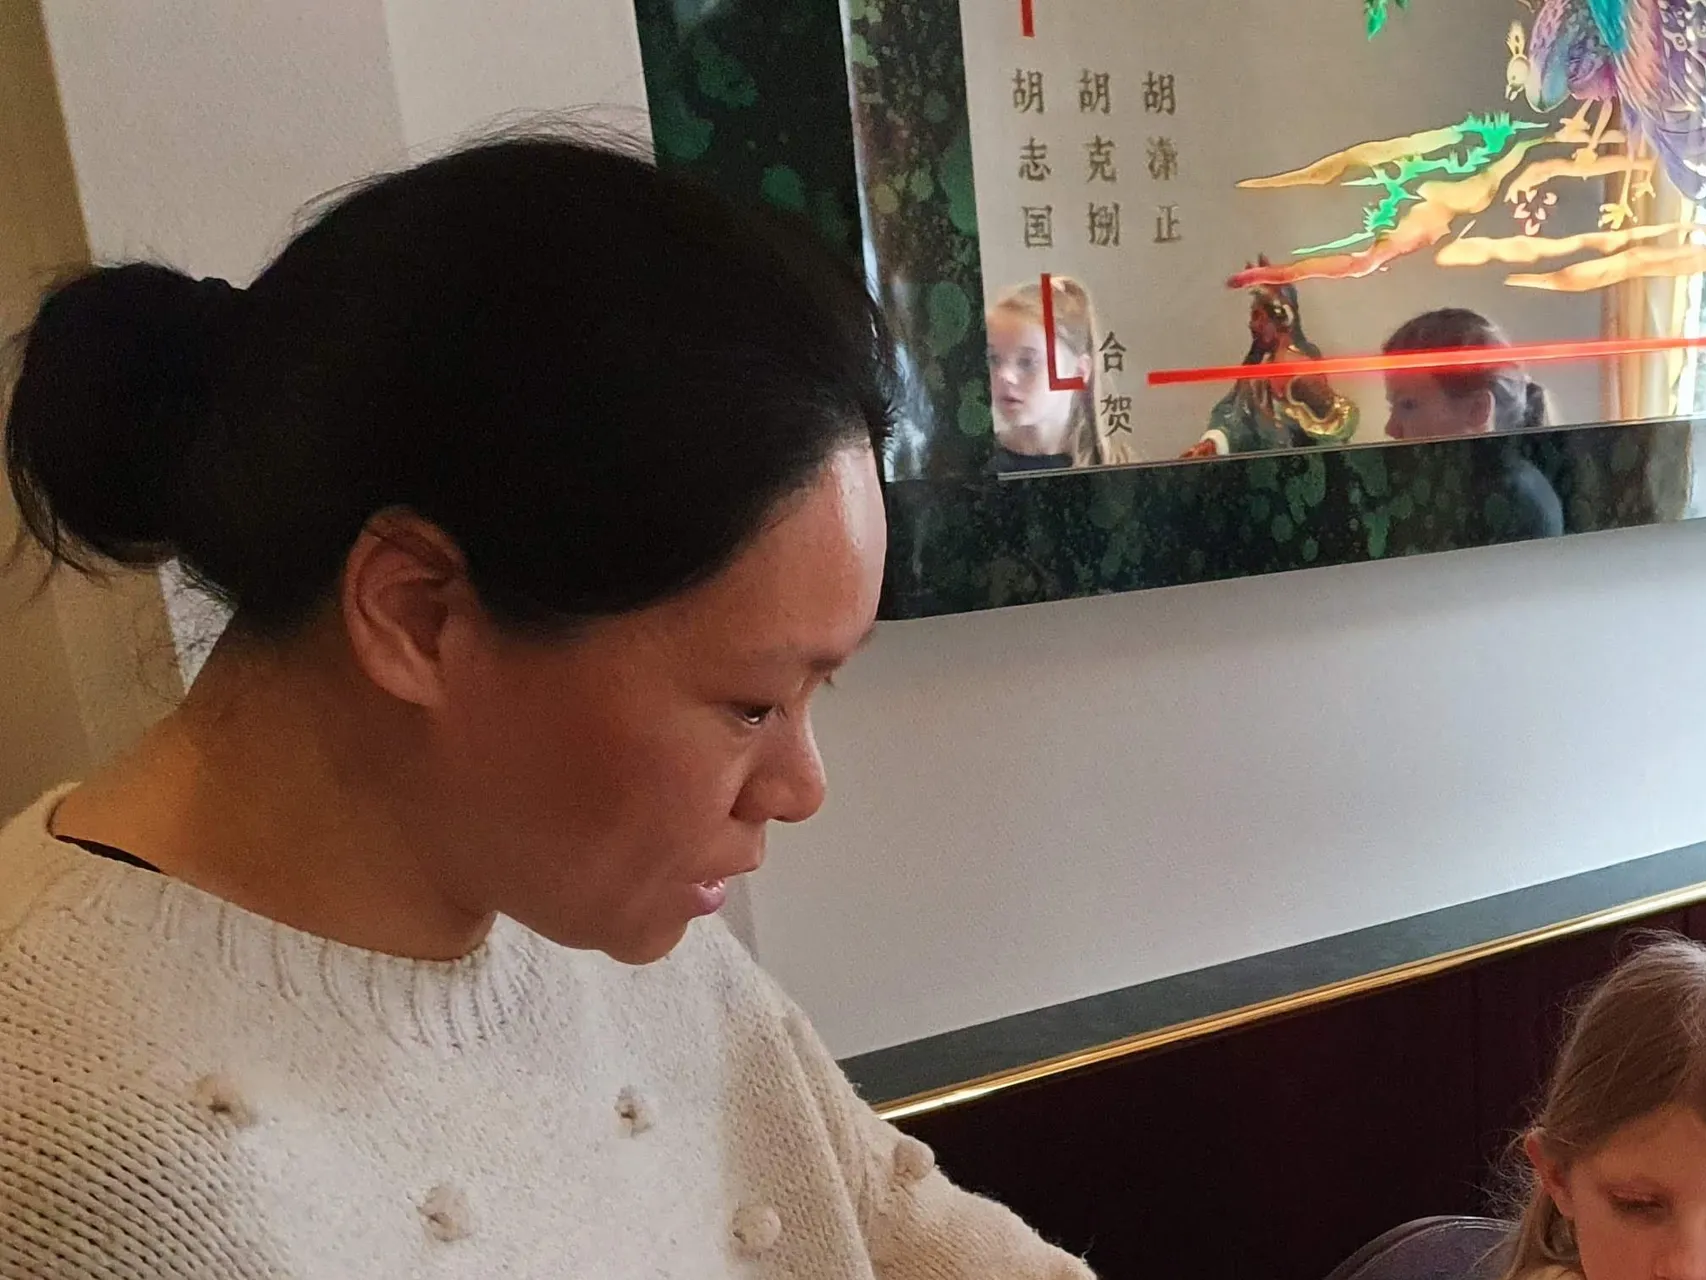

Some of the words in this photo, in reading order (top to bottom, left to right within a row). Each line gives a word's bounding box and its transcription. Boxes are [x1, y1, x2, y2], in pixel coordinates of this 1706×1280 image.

[1011, 67, 1054, 248] 胡志国
[1098, 330, 1133, 438] 合贺
